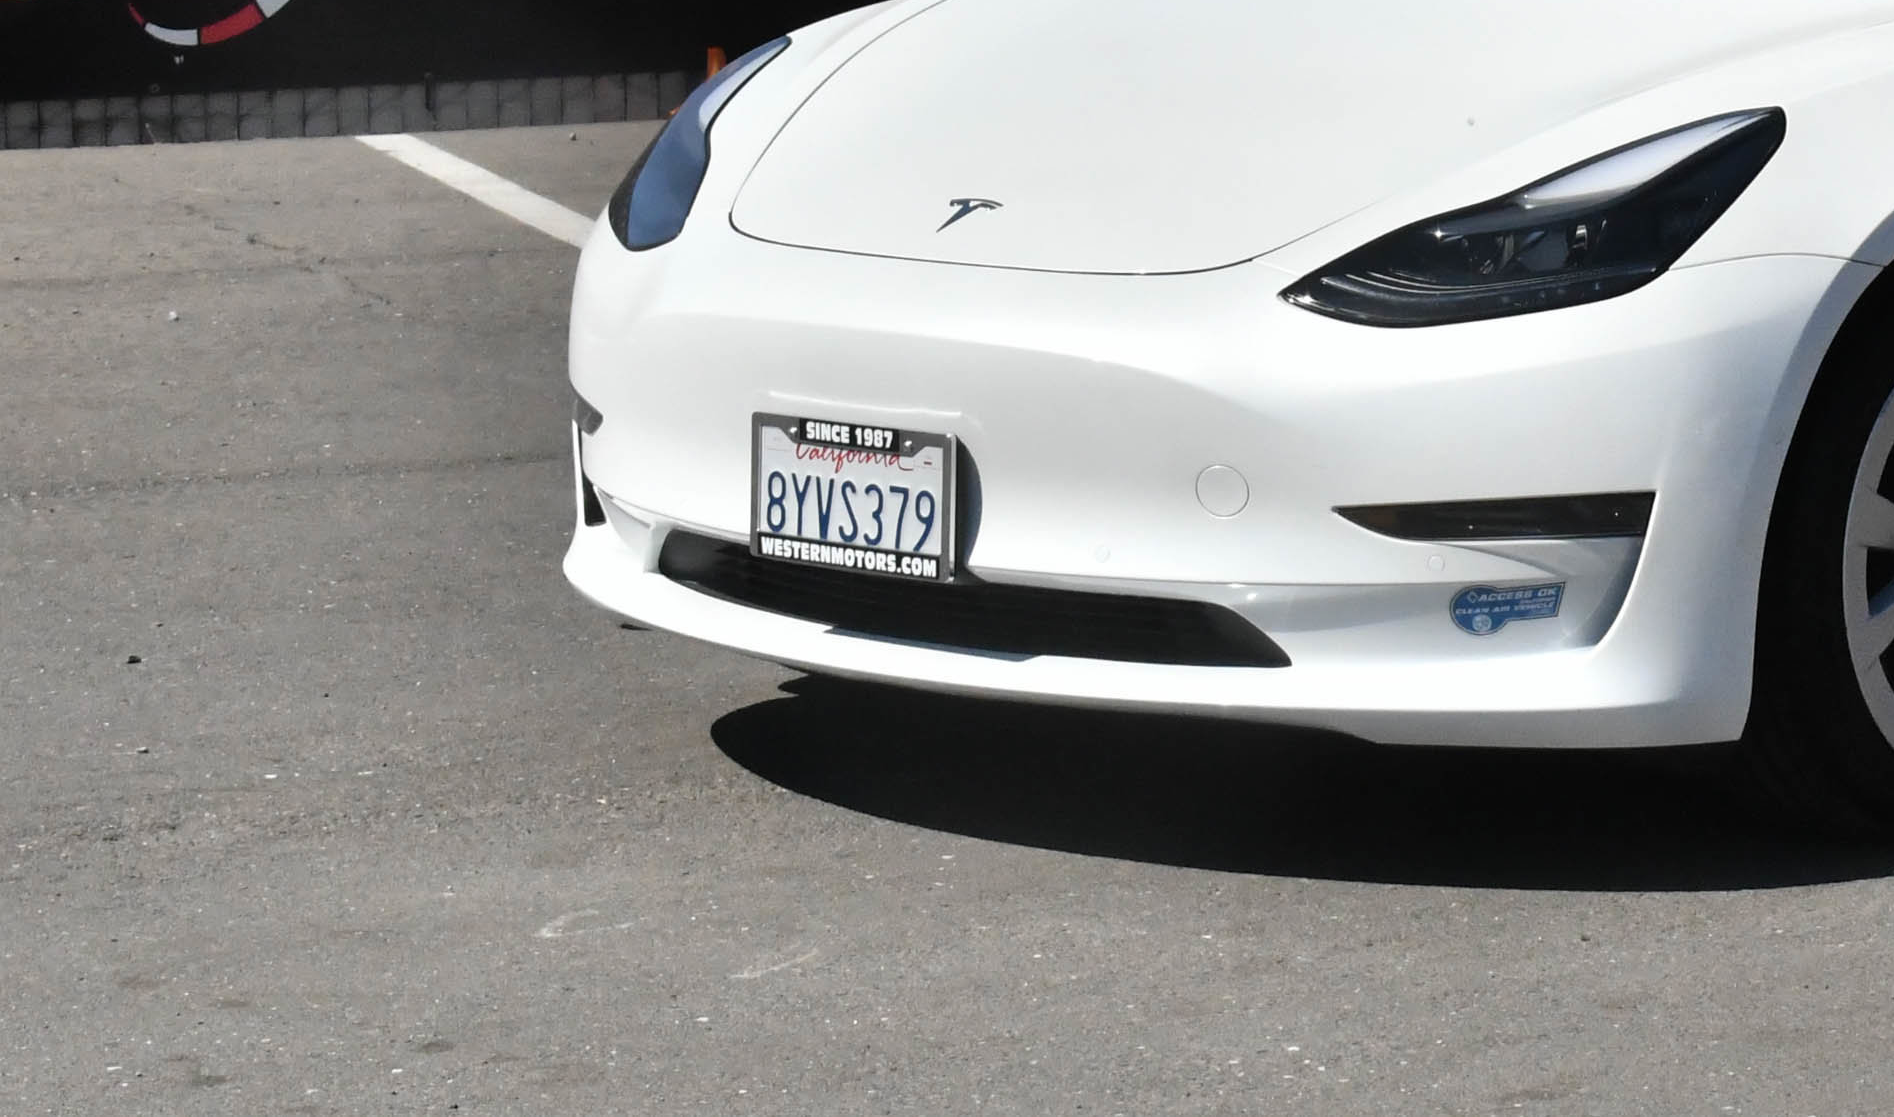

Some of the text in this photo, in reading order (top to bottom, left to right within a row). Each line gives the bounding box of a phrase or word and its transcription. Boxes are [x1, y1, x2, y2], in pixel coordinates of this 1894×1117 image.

[805, 421, 894, 449] SINCE 1987
[766, 470, 936, 553] 8YVS379
[760, 535, 937, 578] WESTERNMOTORS.COM
